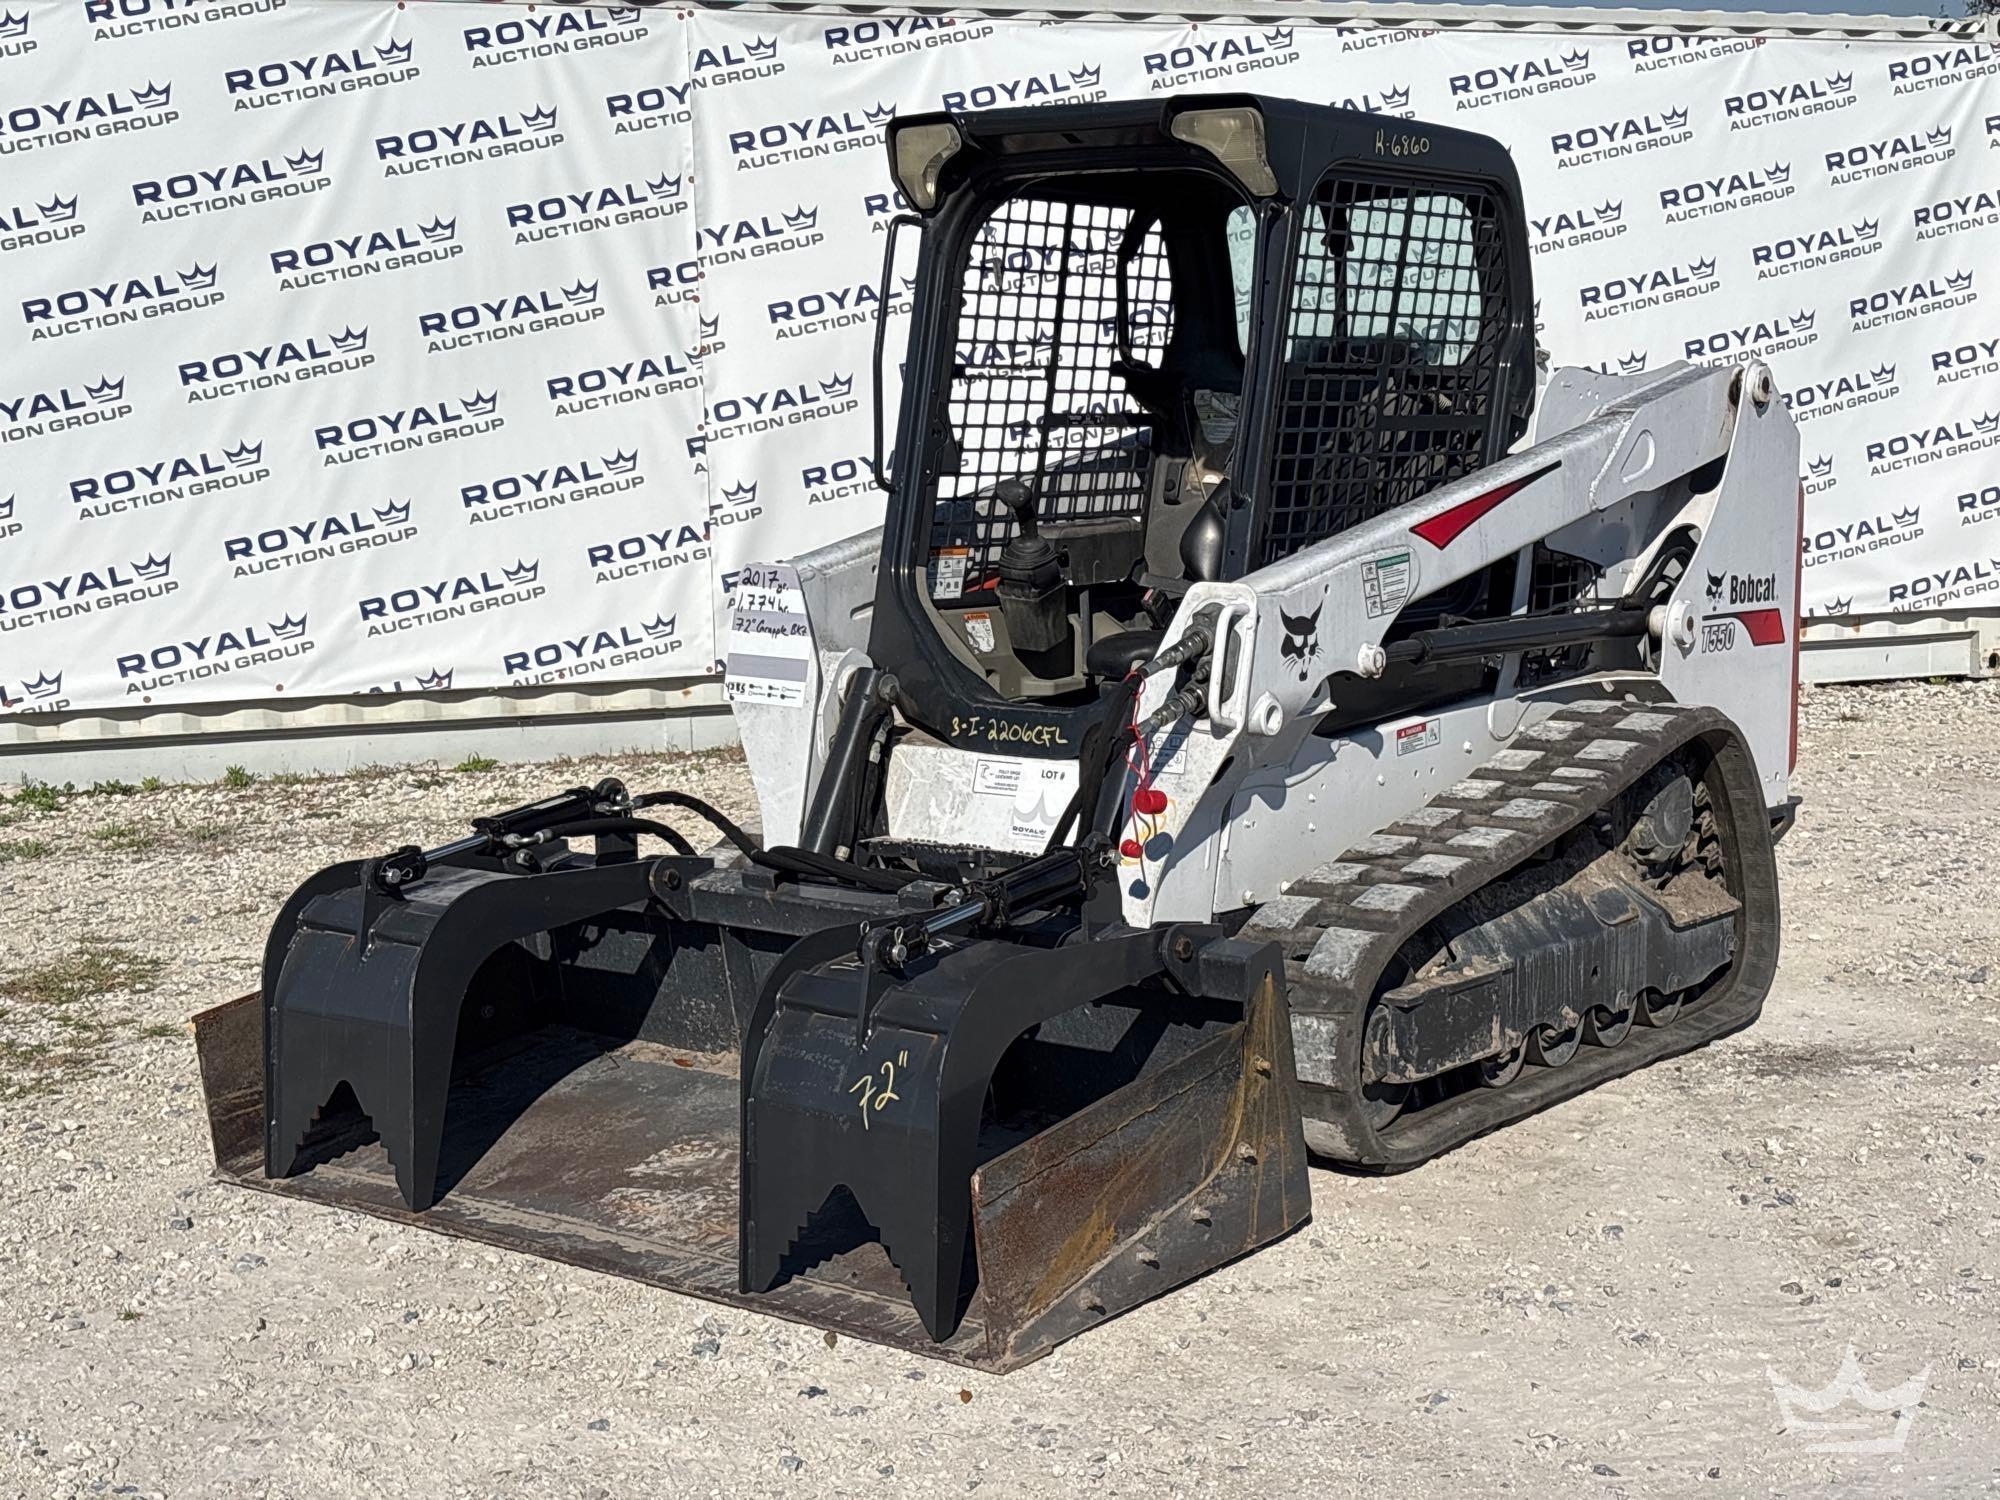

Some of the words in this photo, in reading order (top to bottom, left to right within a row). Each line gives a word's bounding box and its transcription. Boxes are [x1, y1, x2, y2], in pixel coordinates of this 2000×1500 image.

[95, 12, 200, 41] AUCTION
[205, 0, 286, 21] GROUP
[464, 9, 607, 51] ROYAL
[473, 41, 569, 68] AUCTION
[574, 28, 648, 50] GROUP
[833, 39, 921, 65] AUCTION
[925, 26, 993, 48] GROUP
[1144, 36, 1264, 74] ROYAL
[1342, 29, 1420, 52] AUCTION
[1635, 50, 1707, 73] AUCTION
[1710, 36, 1766, 57] GROUP
[225, 49, 376, 94] ROYAL
[712, 63, 785, 85] GROUP
[1152, 65, 1232, 90] AUCTION
[1236, 52, 1299, 73] GROUP
[1449, 58, 1563, 96] ROYAL
[1889, 45, 1990, 81] ROYAL
[235, 83, 336, 111] AUCTION
[341, 68, 420, 92] GROUP
[942, 73, 1071, 113] ROYAL
[1457, 86, 1533, 111] AUCTION
[1537, 73, 1596, 93] GROUP
[1725, 81, 1827, 116] ROYAL
[1894, 72, 1962, 96] AUCTION
[96, 111, 179, 136] GROUP
[1731, 108, 1799, 131] AUCTION
[1802, 96, 1856, 115] GROUP
[375, 116, 522, 160] ROYAL
[729, 113, 865, 154] ROYAL
[1551, 116, 1662, 154] ROYAL
[1558, 144, 1632, 169] AUCTION
[1636, 131, 1693, 151] GROUP
[385, 149, 483, 177] AUCTION
[488, 134, 564, 157] GROUP
[738, 144, 829, 171] AUCTION
[1825, 135, 1926, 171] ROYAL
[1831, 162, 1899, 186] AUCTION
[1902, 149, 1955, 169] GROUP
[132, 160, 287, 206] ROYAL
[142, 193, 246, 224] AUCTION
[251, 178, 331, 202] GROUP
[1660, 171, 1765, 209] ROYAL
[506, 184, 648, 227] ROYAL
[515, 216, 610, 245] AUCTION
[615, 201, 688, 225] GROUP
[1666, 199, 1737, 224] AUCTION
[1740, 186, 1794, 206] GROUP
[1, 224, 85, 251] GROUP
[751, 233, 823, 257] GROUP
[1568, 225, 1627, 246] GROUP
[1753, 228, 1854, 265] ROYAL
[1916, 217, 1983, 241] AUCTION
[270, 228, 421, 274] ROYAL
[280, 261, 380, 291] AUCTION
[385, 245, 463, 270] GROUP
[1758, 255, 1826, 280] AUCTION
[1830, 242, 1882, 262] GROUP
[22, 275, 179, 323] ROYAL
[1580, 267, 1689, 307] ROYAL
[1585, 295, 1659, 322] AUCTION
[1663, 281, 1720, 303] GROUP
[1850, 280, 1946, 318] ROYAL
[32, 309, 138, 341] AUCTION
[143, 292, 224, 318] GROUP
[419, 291, 563, 336] ROYAL
[428, 324, 525, 353] AUCTION
[529, 308, 605, 332] GROUP
[776, 312, 866, 340] AUCTION
[1852, 307, 1917, 332] AUCTION
[1920, 293, 1977, 314] GROUP
[1685, 320, 1789, 359] ROYAL
[1765, 333, 1817, 355] GROUP
[178, 339, 331, 386] ROYAL
[188, 372, 290, 403] AUCTION
[295, 355, 375, 380] GROUP
[547, 355, 687, 400] ROYAL
[556, 387, 650, 416] AUCTION
[788, 400, 858, 424] GROUP
[1847, 387, 1899, 408] GROUP
[49, 405, 132, 432] GROUP
[315, 403, 462, 450] ROYAL
[324, 435, 423, 467] AUCTION
[428, 418, 504, 444] GROUP
[1867, 423, 1973, 462] ROYAL
[70, 454, 225, 503] ROYAL
[1871, 450, 1942, 476] AUCTION
[80, 487, 184, 520] AUCTION
[189, 469, 270, 495] GROUP
[461, 461, 603, 508] ROYAL
[470, 494, 565, 525] AUCTION
[570, 476, 644, 501] GROUP
[224, 512, 375, 561] ROYAL
[234, 546, 335, 578] AUCTION
[340, 527, 417, 553] GROUP
[1868, 529, 1923, 550] GROUP
[596, 553, 688, 583] AUCTION
[742, 567, 779, 590] 2017
[1890, 562, 1991, 603] ROYAL
[96, 581, 178, 609] GROUP
[359, 572, 504, 621] ROYAL
[737, 592, 776, 613] 1,774
[1730, 573, 1776, 606] Bobcat
[368, 605, 465, 637] AUCTION
[470, 586, 545, 612] GROUP
[756, 620, 789, 639] Grapple
[117, 627, 270, 678] ROYAL
[503, 627, 643, 675] ROYAL
[610, 640, 682, 666] GROUP
[1702, 621, 1736, 654] T550
[127, 661, 230, 695] AUCTION
[235, 641, 314, 668] GROUP
[1041, 769, 1058, 780] LOT
[1059, 771, 1066, 781] #
[848, 1050, 909, 1130] 72"
